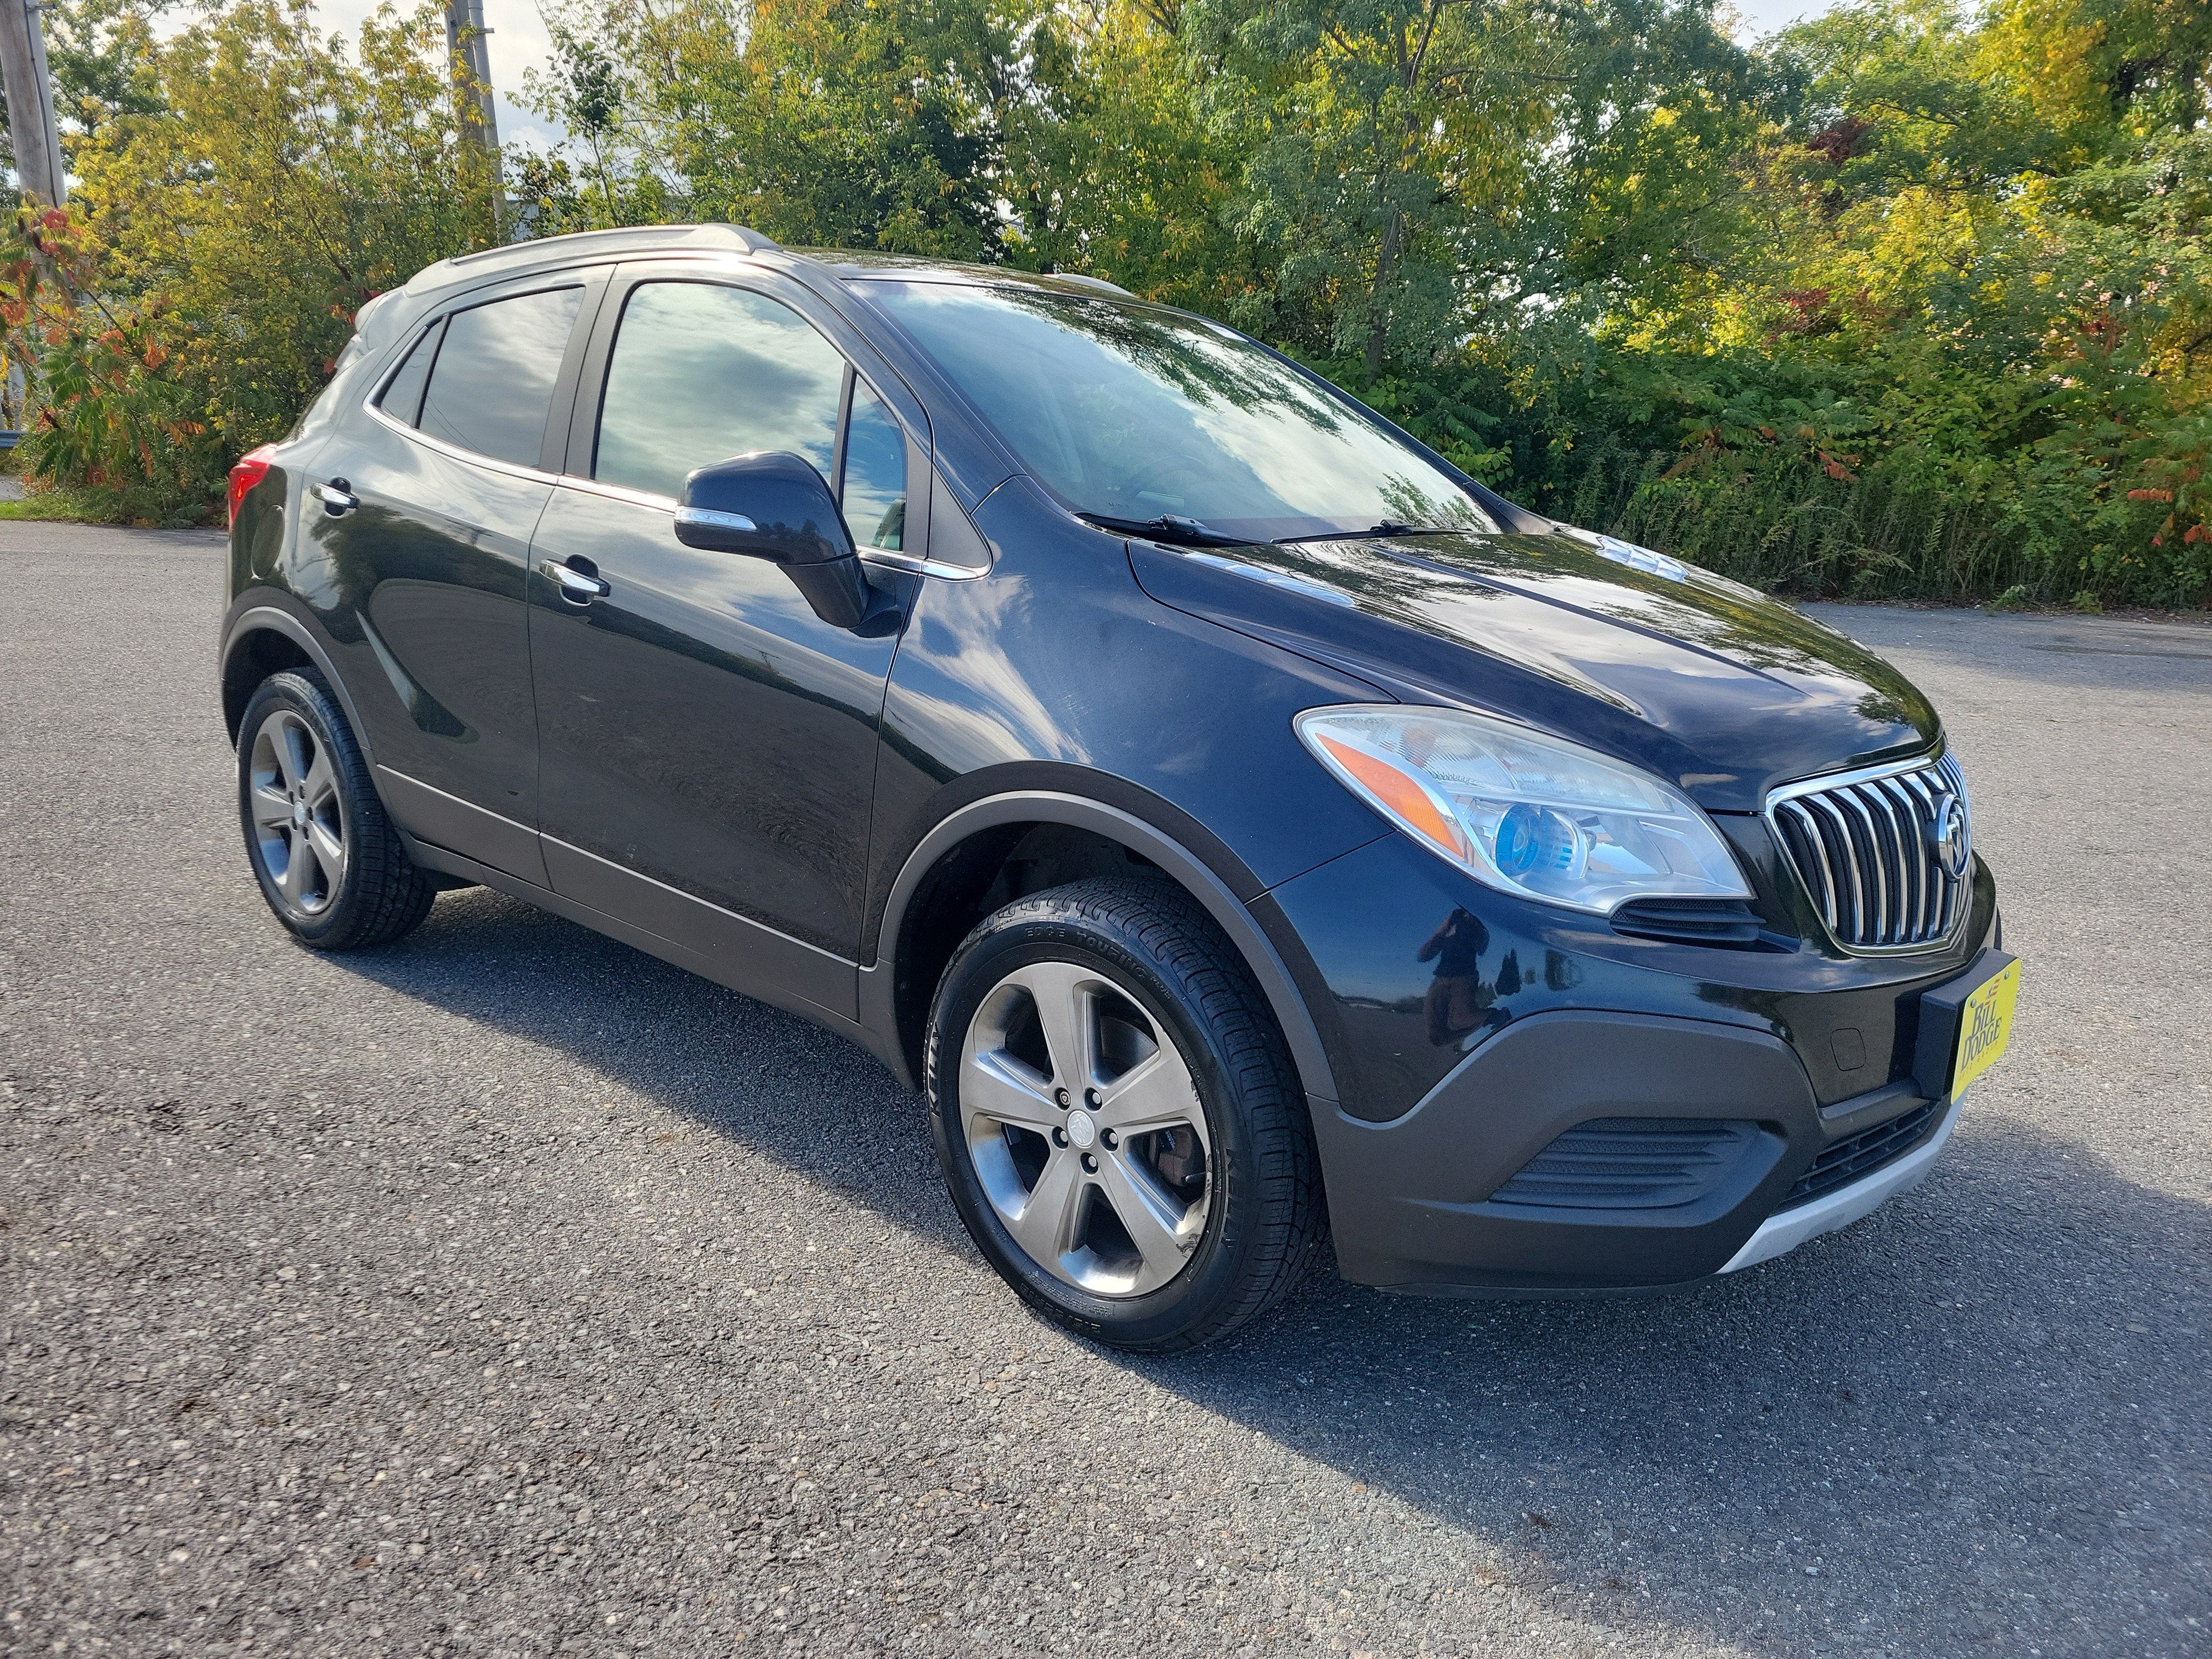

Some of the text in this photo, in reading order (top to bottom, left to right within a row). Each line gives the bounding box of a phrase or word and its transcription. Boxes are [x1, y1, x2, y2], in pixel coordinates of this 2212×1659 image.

[1024, 926, 1066, 938] EDGE
[1076, 931, 1148, 979] TOURING
[1971, 999, 1997, 1037] BILL
[1960, 1016, 2002, 1074] DODGE
